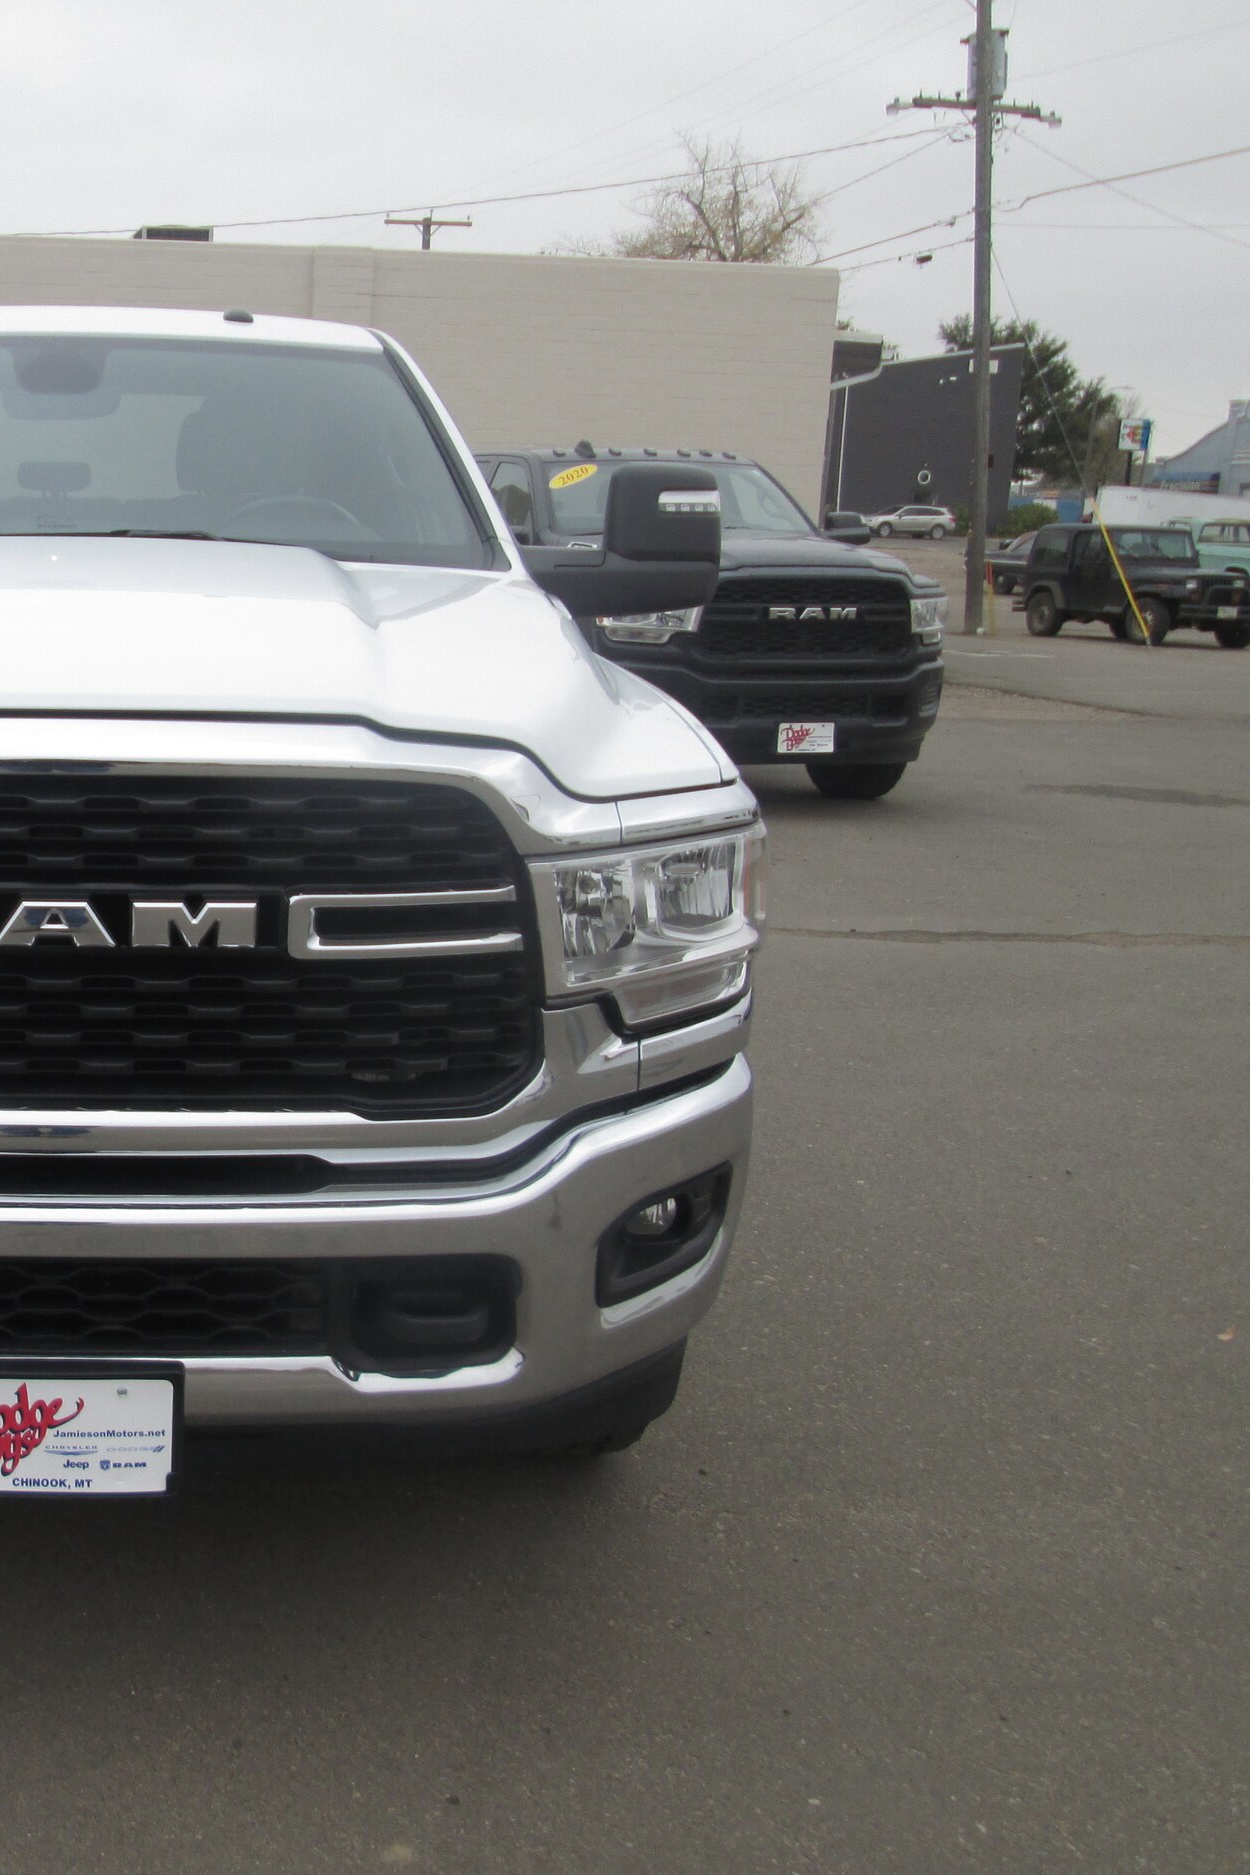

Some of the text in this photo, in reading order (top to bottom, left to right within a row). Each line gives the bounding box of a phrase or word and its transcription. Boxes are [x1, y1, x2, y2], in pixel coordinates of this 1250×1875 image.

[558, 466, 589, 485] 2020
[768, 607, 857, 620] RAM
[53, 1430, 166, 1438] JamiesonMotors.net
[63, 1459, 90, 1470] Jeep
[12, 1477, 93, 1489] CHINOOK, MT
